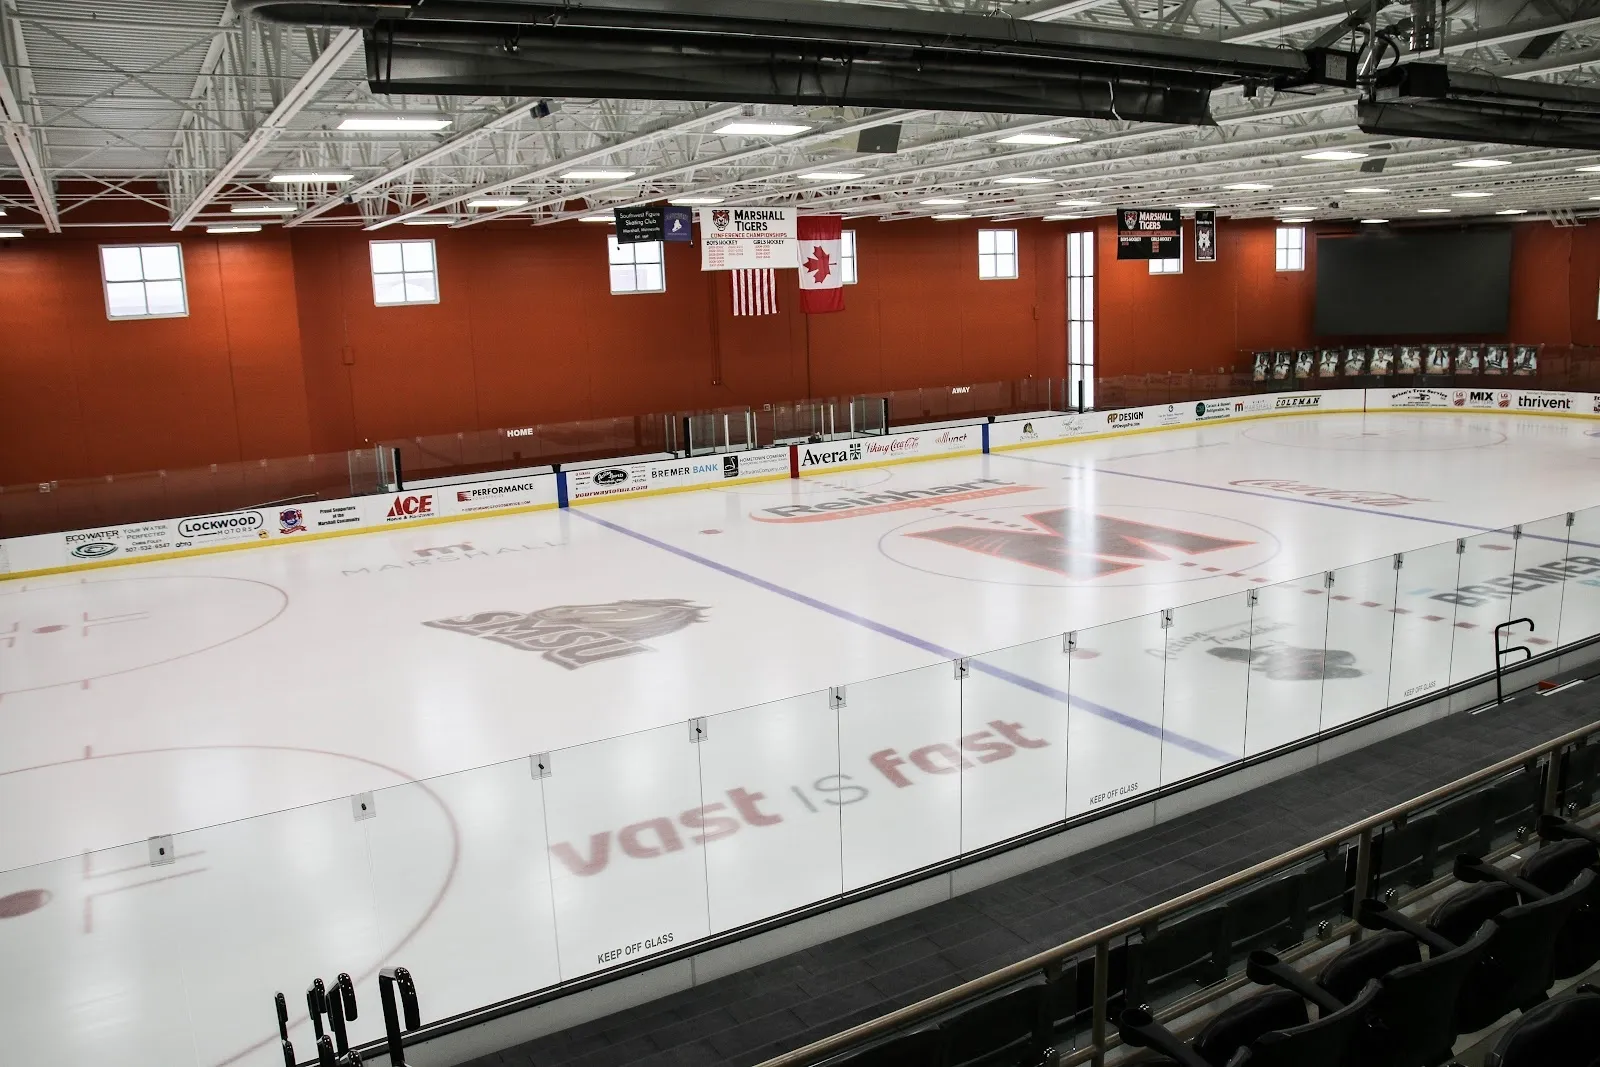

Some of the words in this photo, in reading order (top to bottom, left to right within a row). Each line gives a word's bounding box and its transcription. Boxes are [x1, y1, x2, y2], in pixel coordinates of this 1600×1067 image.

[645, 210, 660, 218] Figure
[734, 209, 785, 221] MARSHALL
[1139, 211, 1173, 221] MARSHALL
[625, 219, 643, 227] Skating
[734, 220, 768, 231] TIGERS
[1139, 220, 1161, 230] TIGERS
[951, 386, 970, 395] AWAY
[1470, 391, 1494, 401] MIX
[1275, 397, 1320, 407] COLEMAN
[1518, 395, 1571, 409] thrivent
[1107, 412, 1118, 424] AP
[1118, 411, 1144, 422] DESIGN
[506, 428, 534, 438] HOME
[864, 441, 890, 455] Viking
[801, 449, 848, 467] Avera
[651, 466, 691, 479] BREMER
[692, 463, 719, 474] BANK
[472, 482, 534, 497] PERFORMANCE
[761, 477, 1018, 518] Reinhart
[386, 494, 433, 518] ACE
[185, 516, 256, 533] LOCKWOOD
[217, 526, 253, 536] MOTORS
[126, 531, 166, 540] PERFECTED
[341, 541, 569, 576] MARSHALL
[550, 785, 784, 878] vast
[790, 773, 870, 815] IS
[867, 719, 1052, 789] fast
[1089, 793, 1106, 806] KEEP
[1106, 788, 1119, 800] OFF
[1119, 782, 1139, 795] GLASS
[597, 948, 623, 965] KEEP
[624, 942, 642, 956] OFF
[644, 932, 674, 950] GLASS
